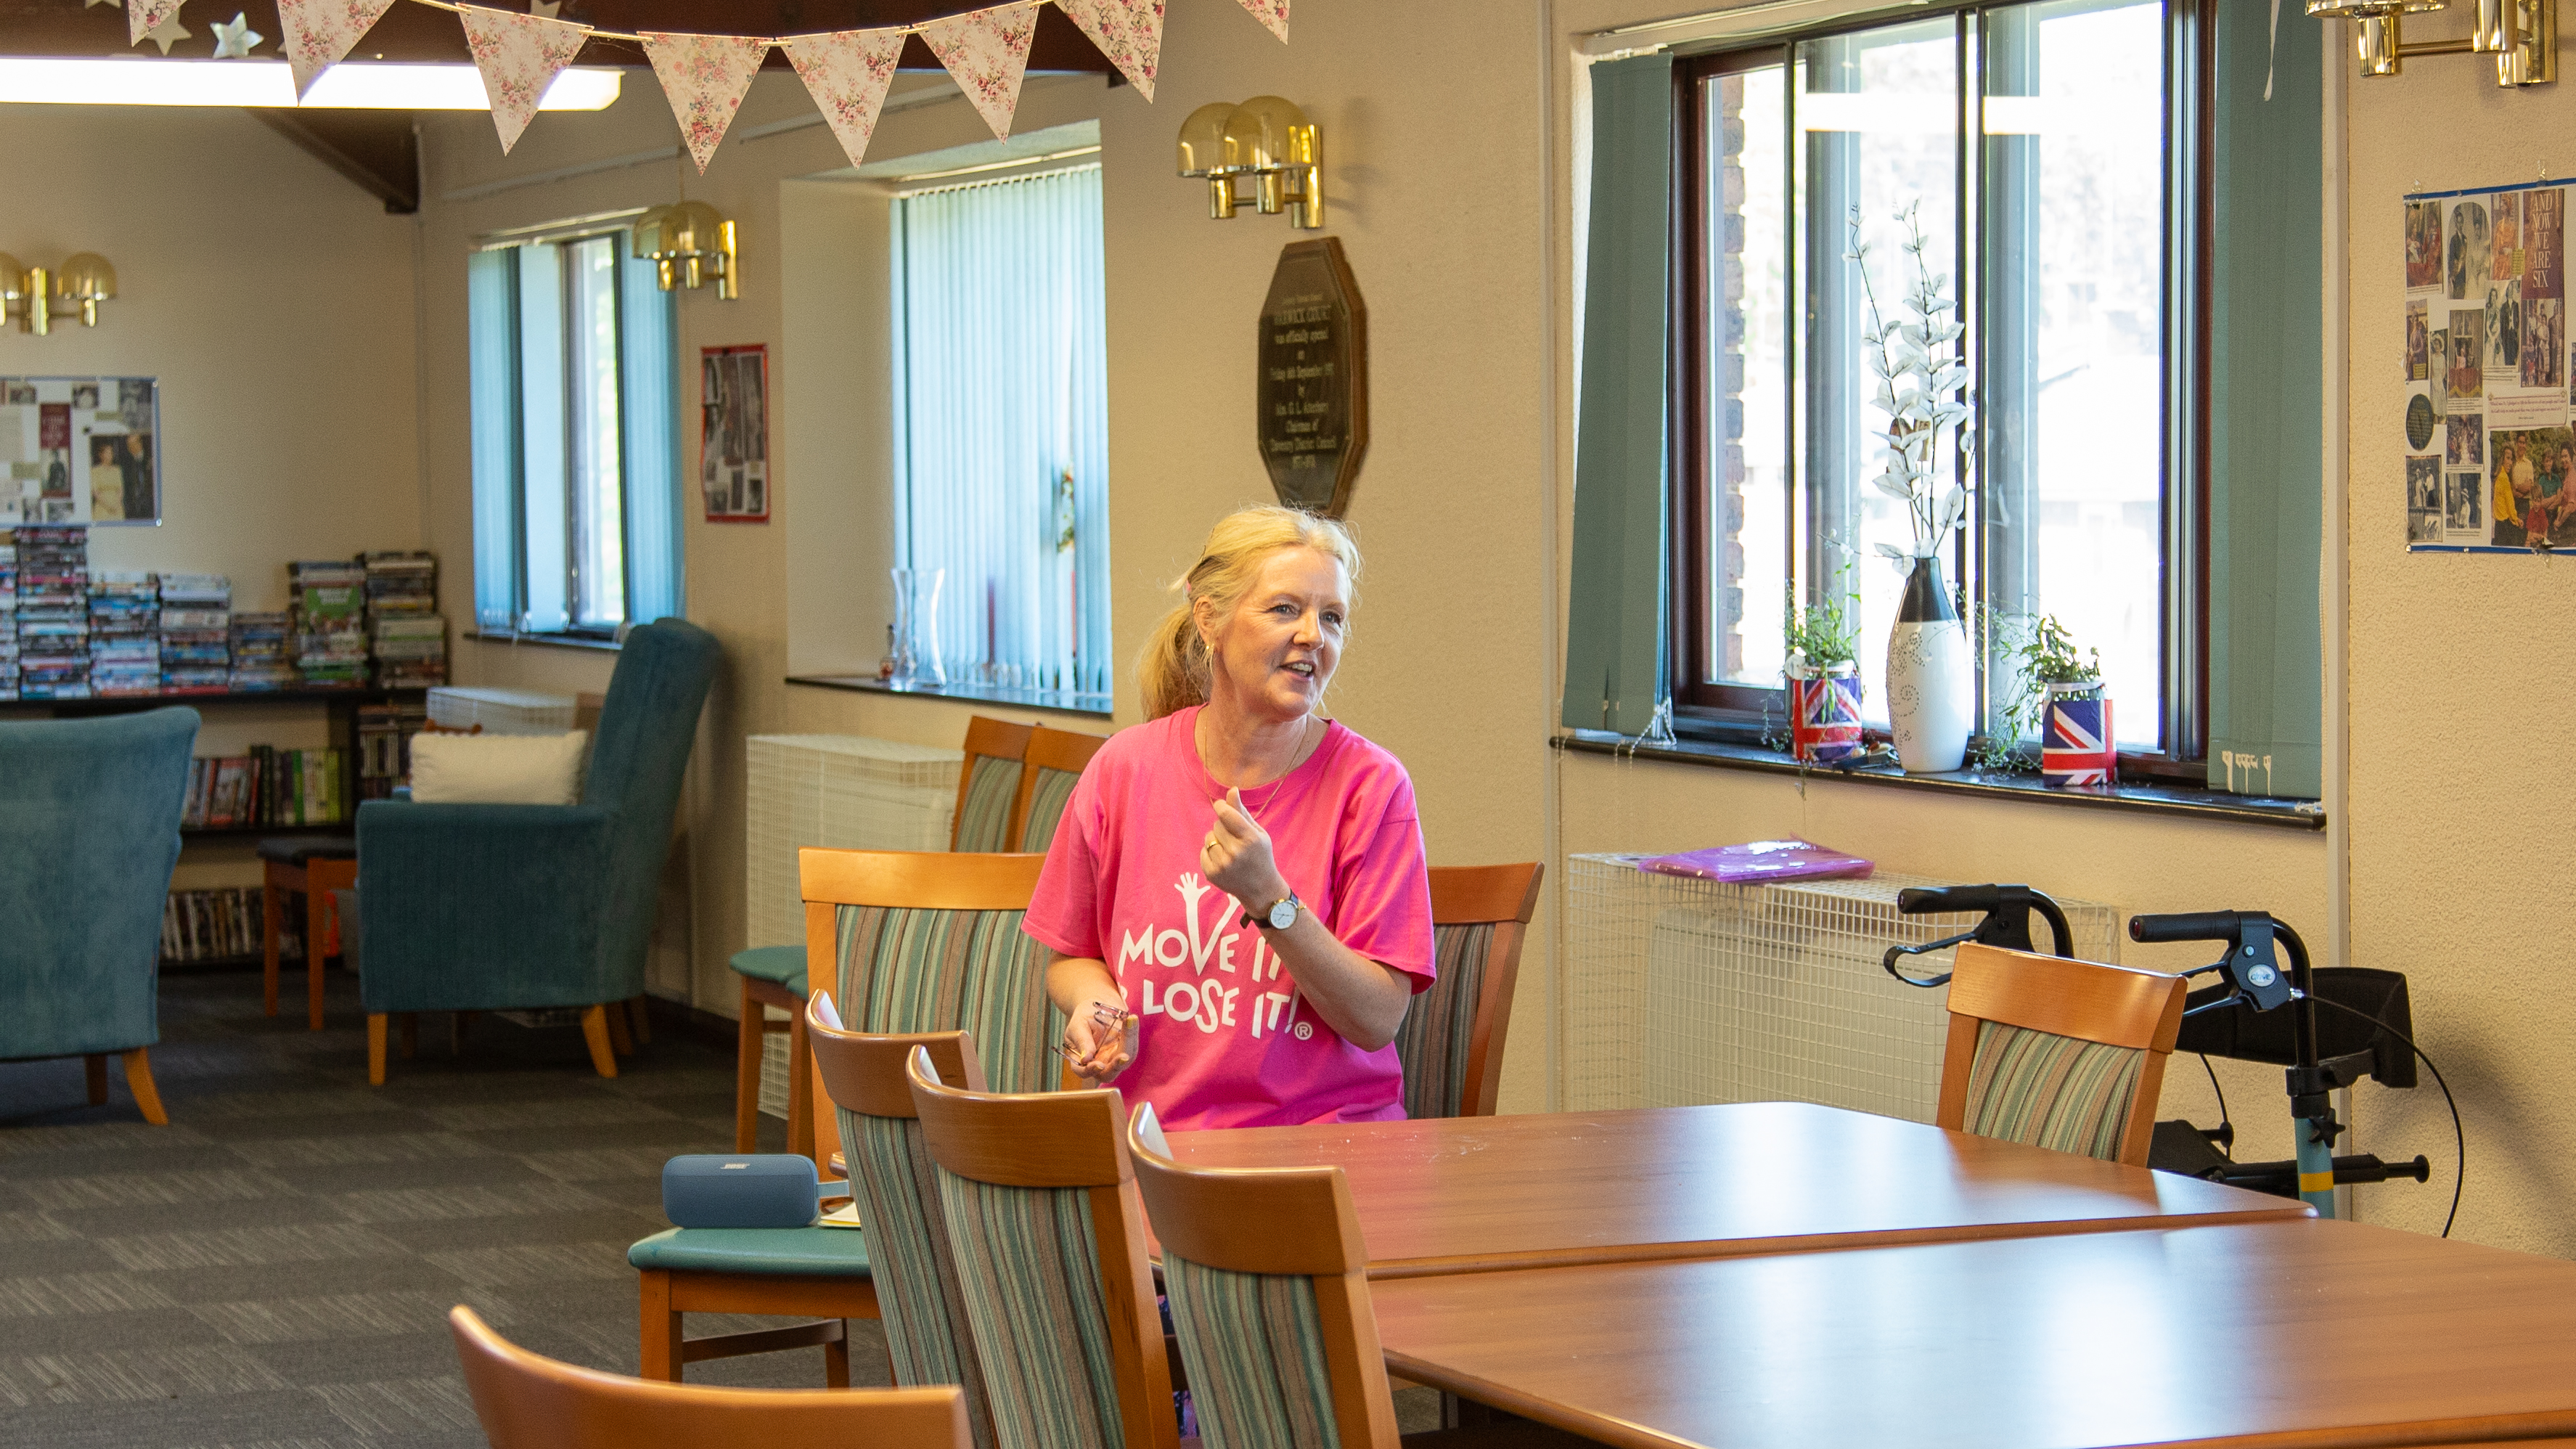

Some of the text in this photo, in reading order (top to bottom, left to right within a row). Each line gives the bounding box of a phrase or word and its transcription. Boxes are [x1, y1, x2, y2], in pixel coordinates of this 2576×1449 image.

[2532, 192, 2553, 211] AND
[2532, 212, 2553, 230] NOW
[2534, 232, 2549, 249] WE
[2532, 250, 2551, 269] ARE
[2532, 270, 2548, 287] SIX
[1118, 872, 1239, 977] MOVE
[1142, 979, 1240, 1034] LOSE
